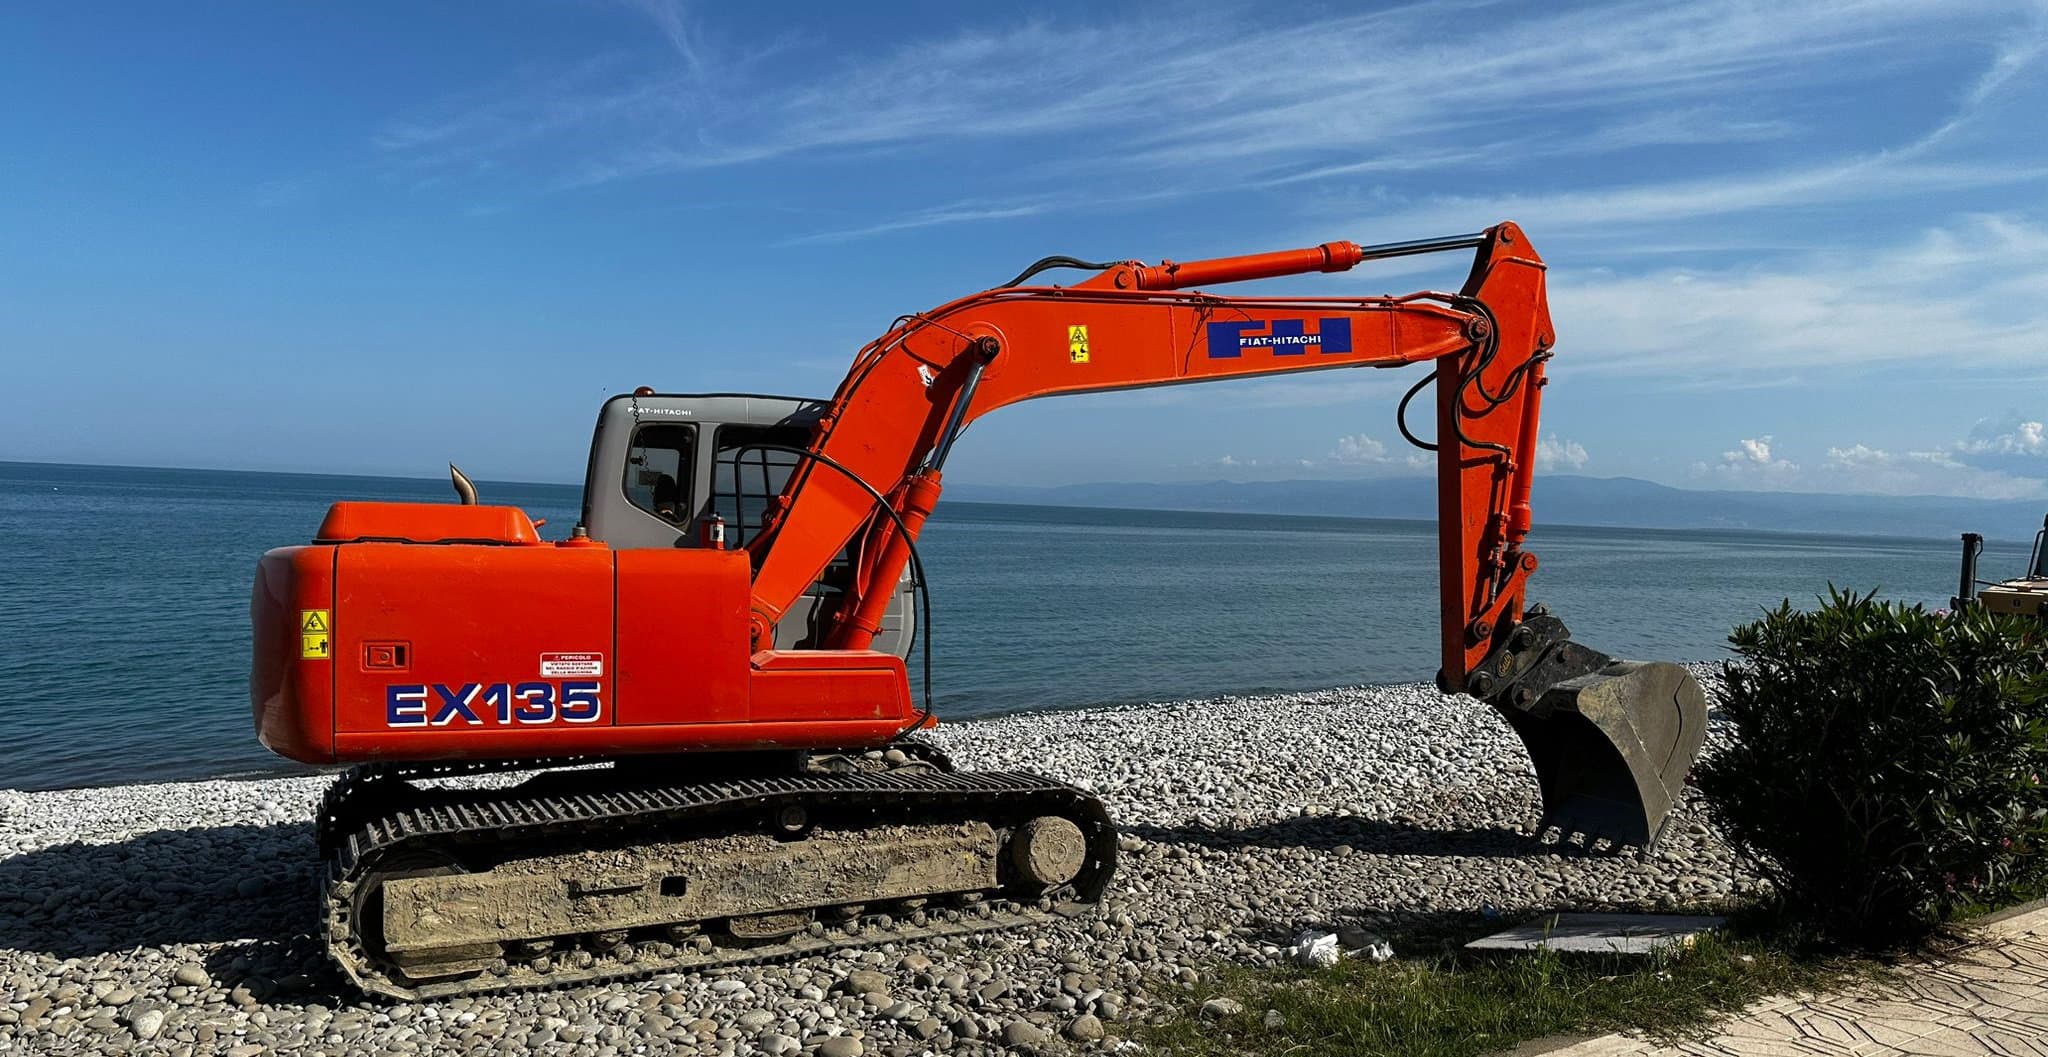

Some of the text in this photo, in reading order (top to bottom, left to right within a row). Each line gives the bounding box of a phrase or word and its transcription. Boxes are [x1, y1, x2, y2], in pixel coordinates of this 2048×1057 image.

[1240, 335, 1321, 346] FIAT-HITACHI
[627, 407, 692, 416] FAT-HITACHI
[387, 681, 601, 727] EX135
